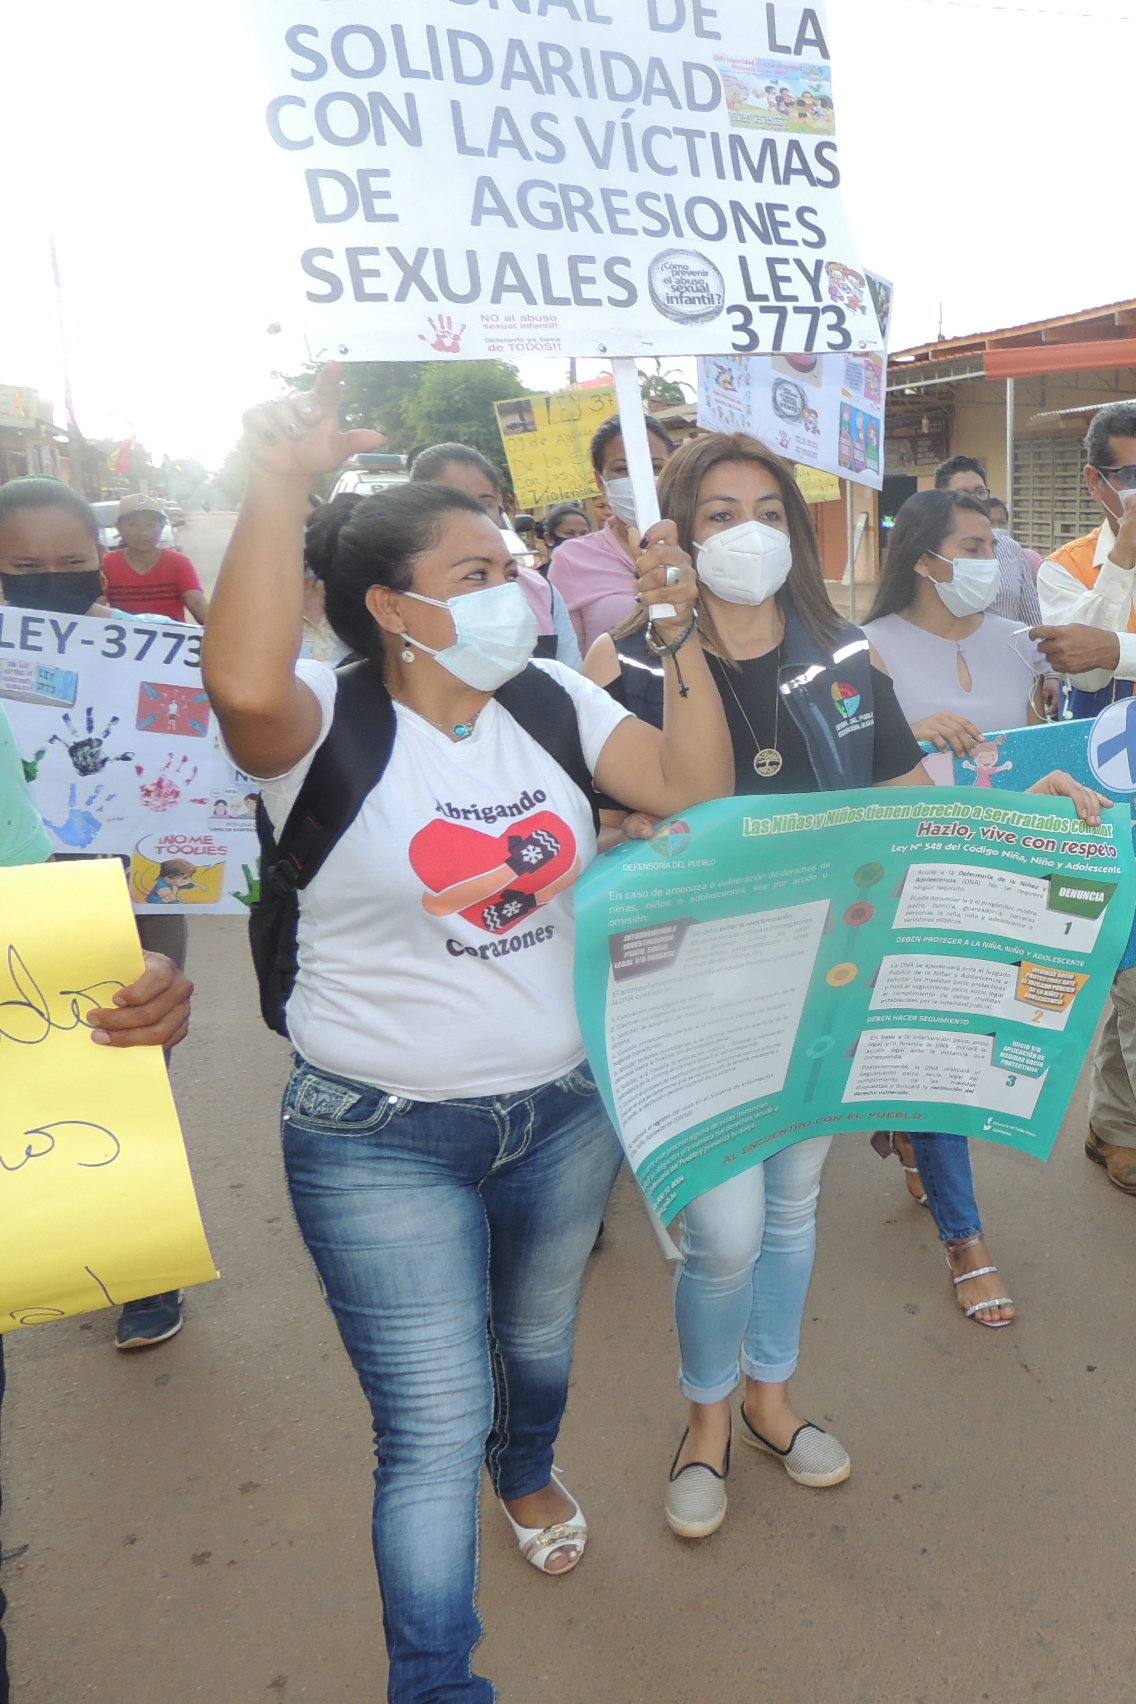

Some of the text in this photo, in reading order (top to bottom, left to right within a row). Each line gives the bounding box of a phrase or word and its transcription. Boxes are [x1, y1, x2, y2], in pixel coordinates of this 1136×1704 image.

[766, 3, 830, 60] LA
[284, 23, 722, 113] SOLIDARIDAD
[266, 91, 842, 190] CON LAS VÍCTIMAS
[302, 167, 828, 250] DE AGRESIONES
[299, 246, 825, 309] SEXUALES LEY
[663, 276, 705, 286] el abuso
[671, 268, 709, 278] prevenir
[670, 283, 710, 294] sexual
[665, 292, 723, 306] infantil?
[479, 313, 558, 323] NO al abuso
[483, 322, 516, 330] sexual
[726, 304, 852, 352] 3773
[488, 343, 504, 351] de
[528, 486, 600, 505] Violencia
[0, 612, 203, 668] LEY-3773
[434, 788, 547, 825] Abrigando
[743, 802, 1069, 837] Las Niñas y Niños tienen derecho a ser tratados
[916, 820, 1118, 860] Hazlo, vive con respeto
[622, 857, 717, 873] DEFENSORÍA DEL PUEBLO
[891, 842, 1123, 875] Ley 548 del Código Niña, Niño y Adolescente
[609, 890, 623, 902] En
[624, 889, 650, 901] caso
[651, 887, 664, 899] de
[664, 883, 709, 897] amenaza
[717, 872, 768, 889] vulneración
[768, 871, 780, 879] de
[780, 864, 818, 879] derechos
[820, 861, 832, 871] de
[958, 870, 994, 881] Defensoría
[997, 875, 1006, 883] de
[1020, 880, 1040, 890] Niñez
[608, 902, 640, 915] niñas,
[644, 898, 673, 911] niños
[676, 898, 685, 906] o
[772, 880, 788, 891] por
[1058, 887, 1106, 903] DENUNCIA
[608, 913, 650, 928] omisión:
[1063, 921, 1074, 936] 1
[445, 924, 556, 961] Corazones
[896, 935, 923, 944] DEBEN
[923, 936, 963, 946] PROTEGER
[963, 938, 970, 946] A
[971, 939, 981, 948] LA
[1004, 945, 1025, 956] NIÑO
[1032, 952, 1087, 968] ADOLESCENTE
[613, 957, 634, 969] LEGAL
[866, 1014, 970, 1026] DEBEN HACER SEGUIMIENTO
[1031, 1009, 1045, 1024] 2
[1005, 1074, 1018, 1088] 3
[722, 1111, 923, 1166] AL ENCUENTRO CON EL PUEBLO
